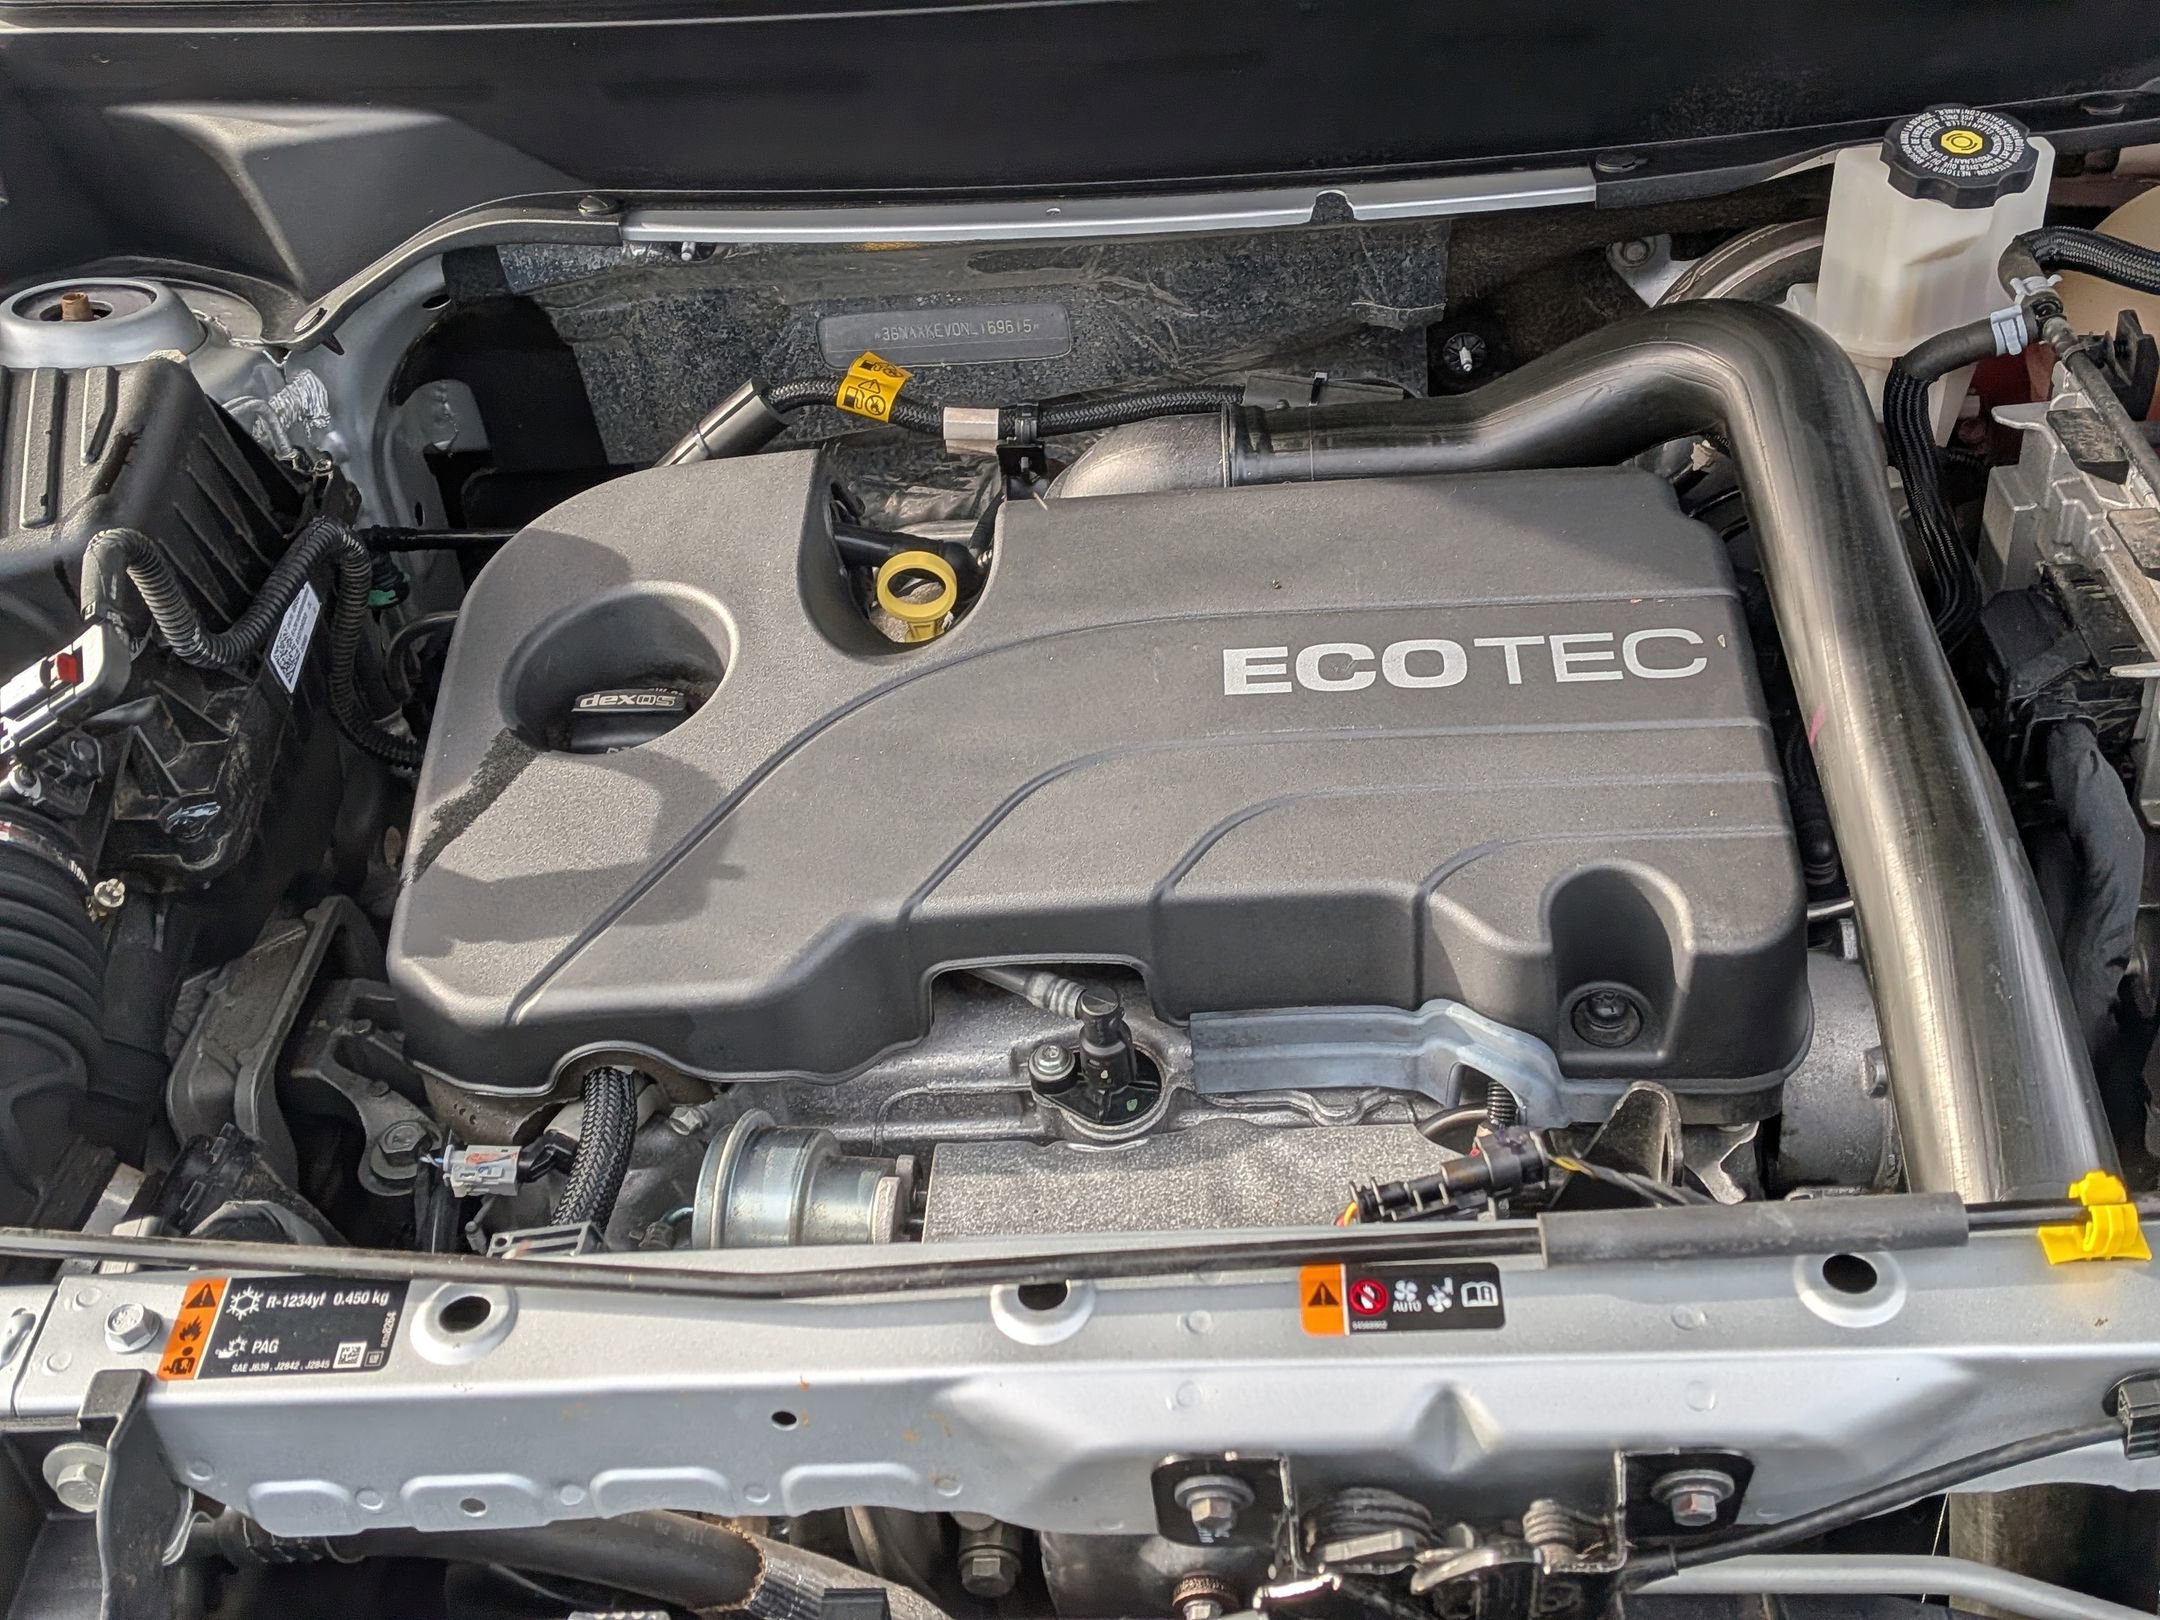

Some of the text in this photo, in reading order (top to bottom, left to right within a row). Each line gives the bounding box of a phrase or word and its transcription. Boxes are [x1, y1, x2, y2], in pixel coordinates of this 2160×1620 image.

[1979, 112, 2008, 126] SEALED
[1911, 125, 1926, 137] FREIN
[1972, 123, 1994, 134] CLEAN
[2006, 126, 2021, 139] FROM
[2002, 135, 2013, 151] BEFORE
[1902, 145, 1926, 164] BOUCHON
[1949, 154, 1994, 164] PROVENANT
[1931, 166, 1971, 176] NETTOYER
[1222, 628, 1708, 696] ECOTEC
[579, 694, 677, 708] dexos
[265, 1290, 391, 1310] R-1234yf 0.450 kg
[1392, 1301, 1423, 1313] AUTO
[251, 1338, 280, 1355] PAG
[231, 1363, 248, 1374] SAE
